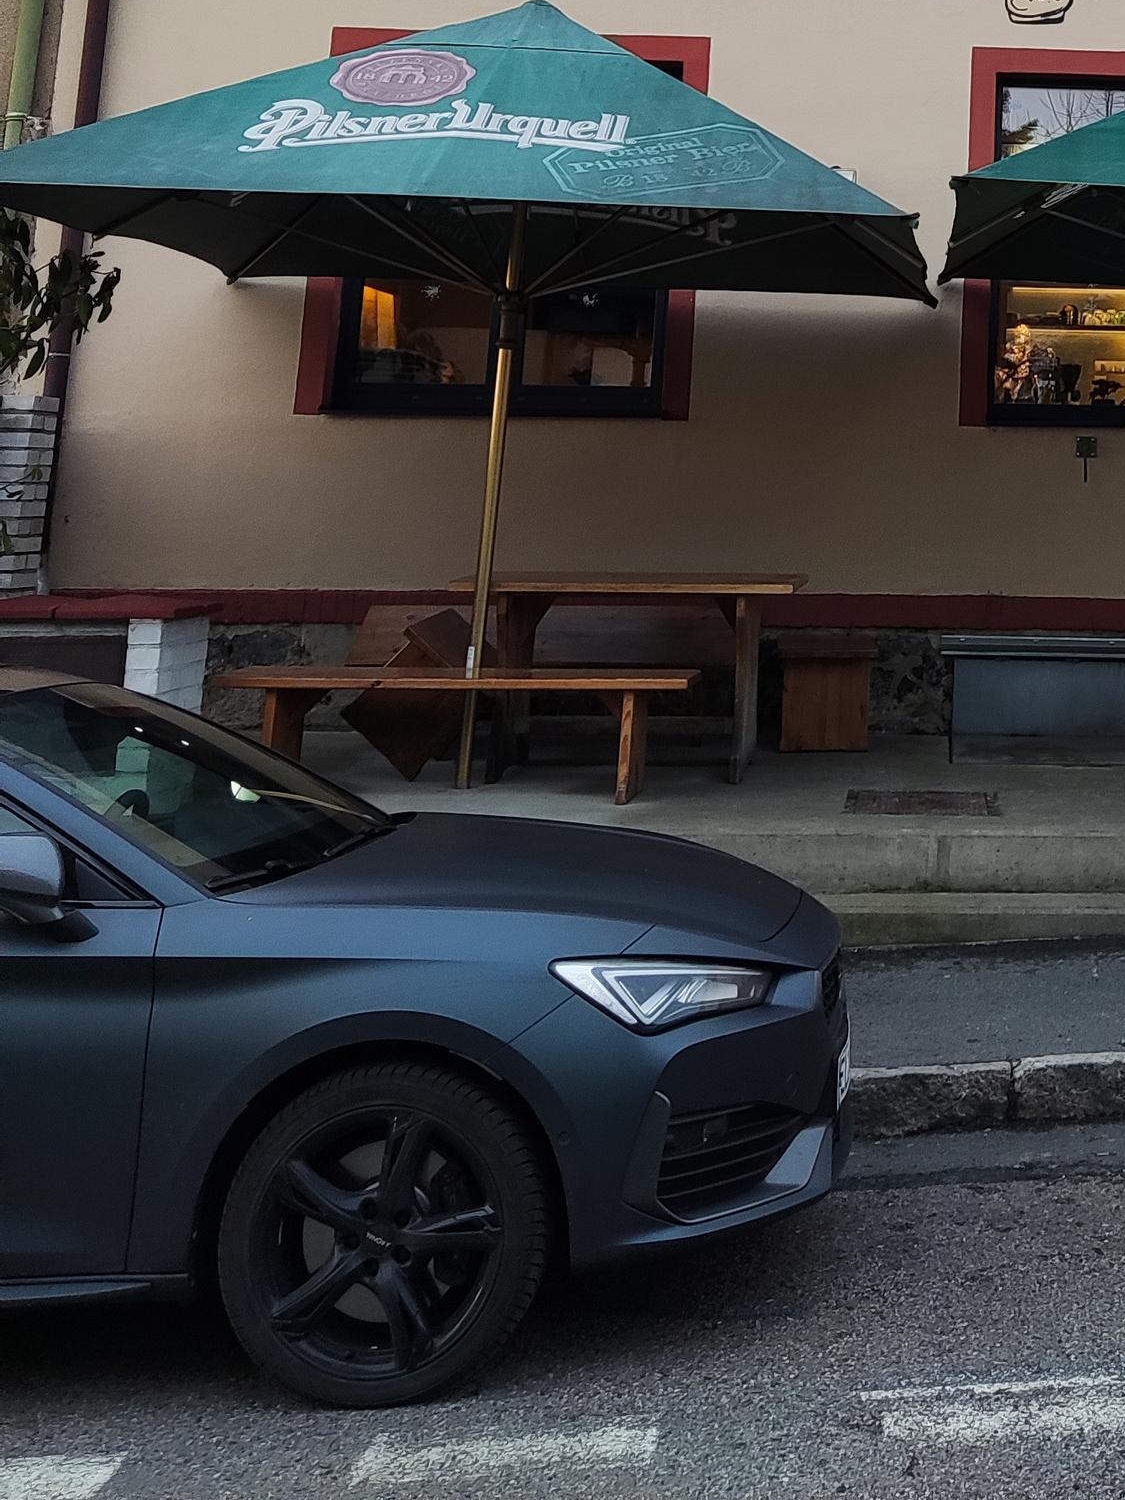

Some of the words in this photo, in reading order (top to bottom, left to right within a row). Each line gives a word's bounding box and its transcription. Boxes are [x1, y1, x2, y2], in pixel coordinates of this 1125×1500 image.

[237, 98, 453, 153] Pilsner
[449, 98, 632, 150] Urquell
[568, 154, 679, 173] Pilsner
[687, 142, 752, 161] Bier
[604, 138, 703, 158] Original
